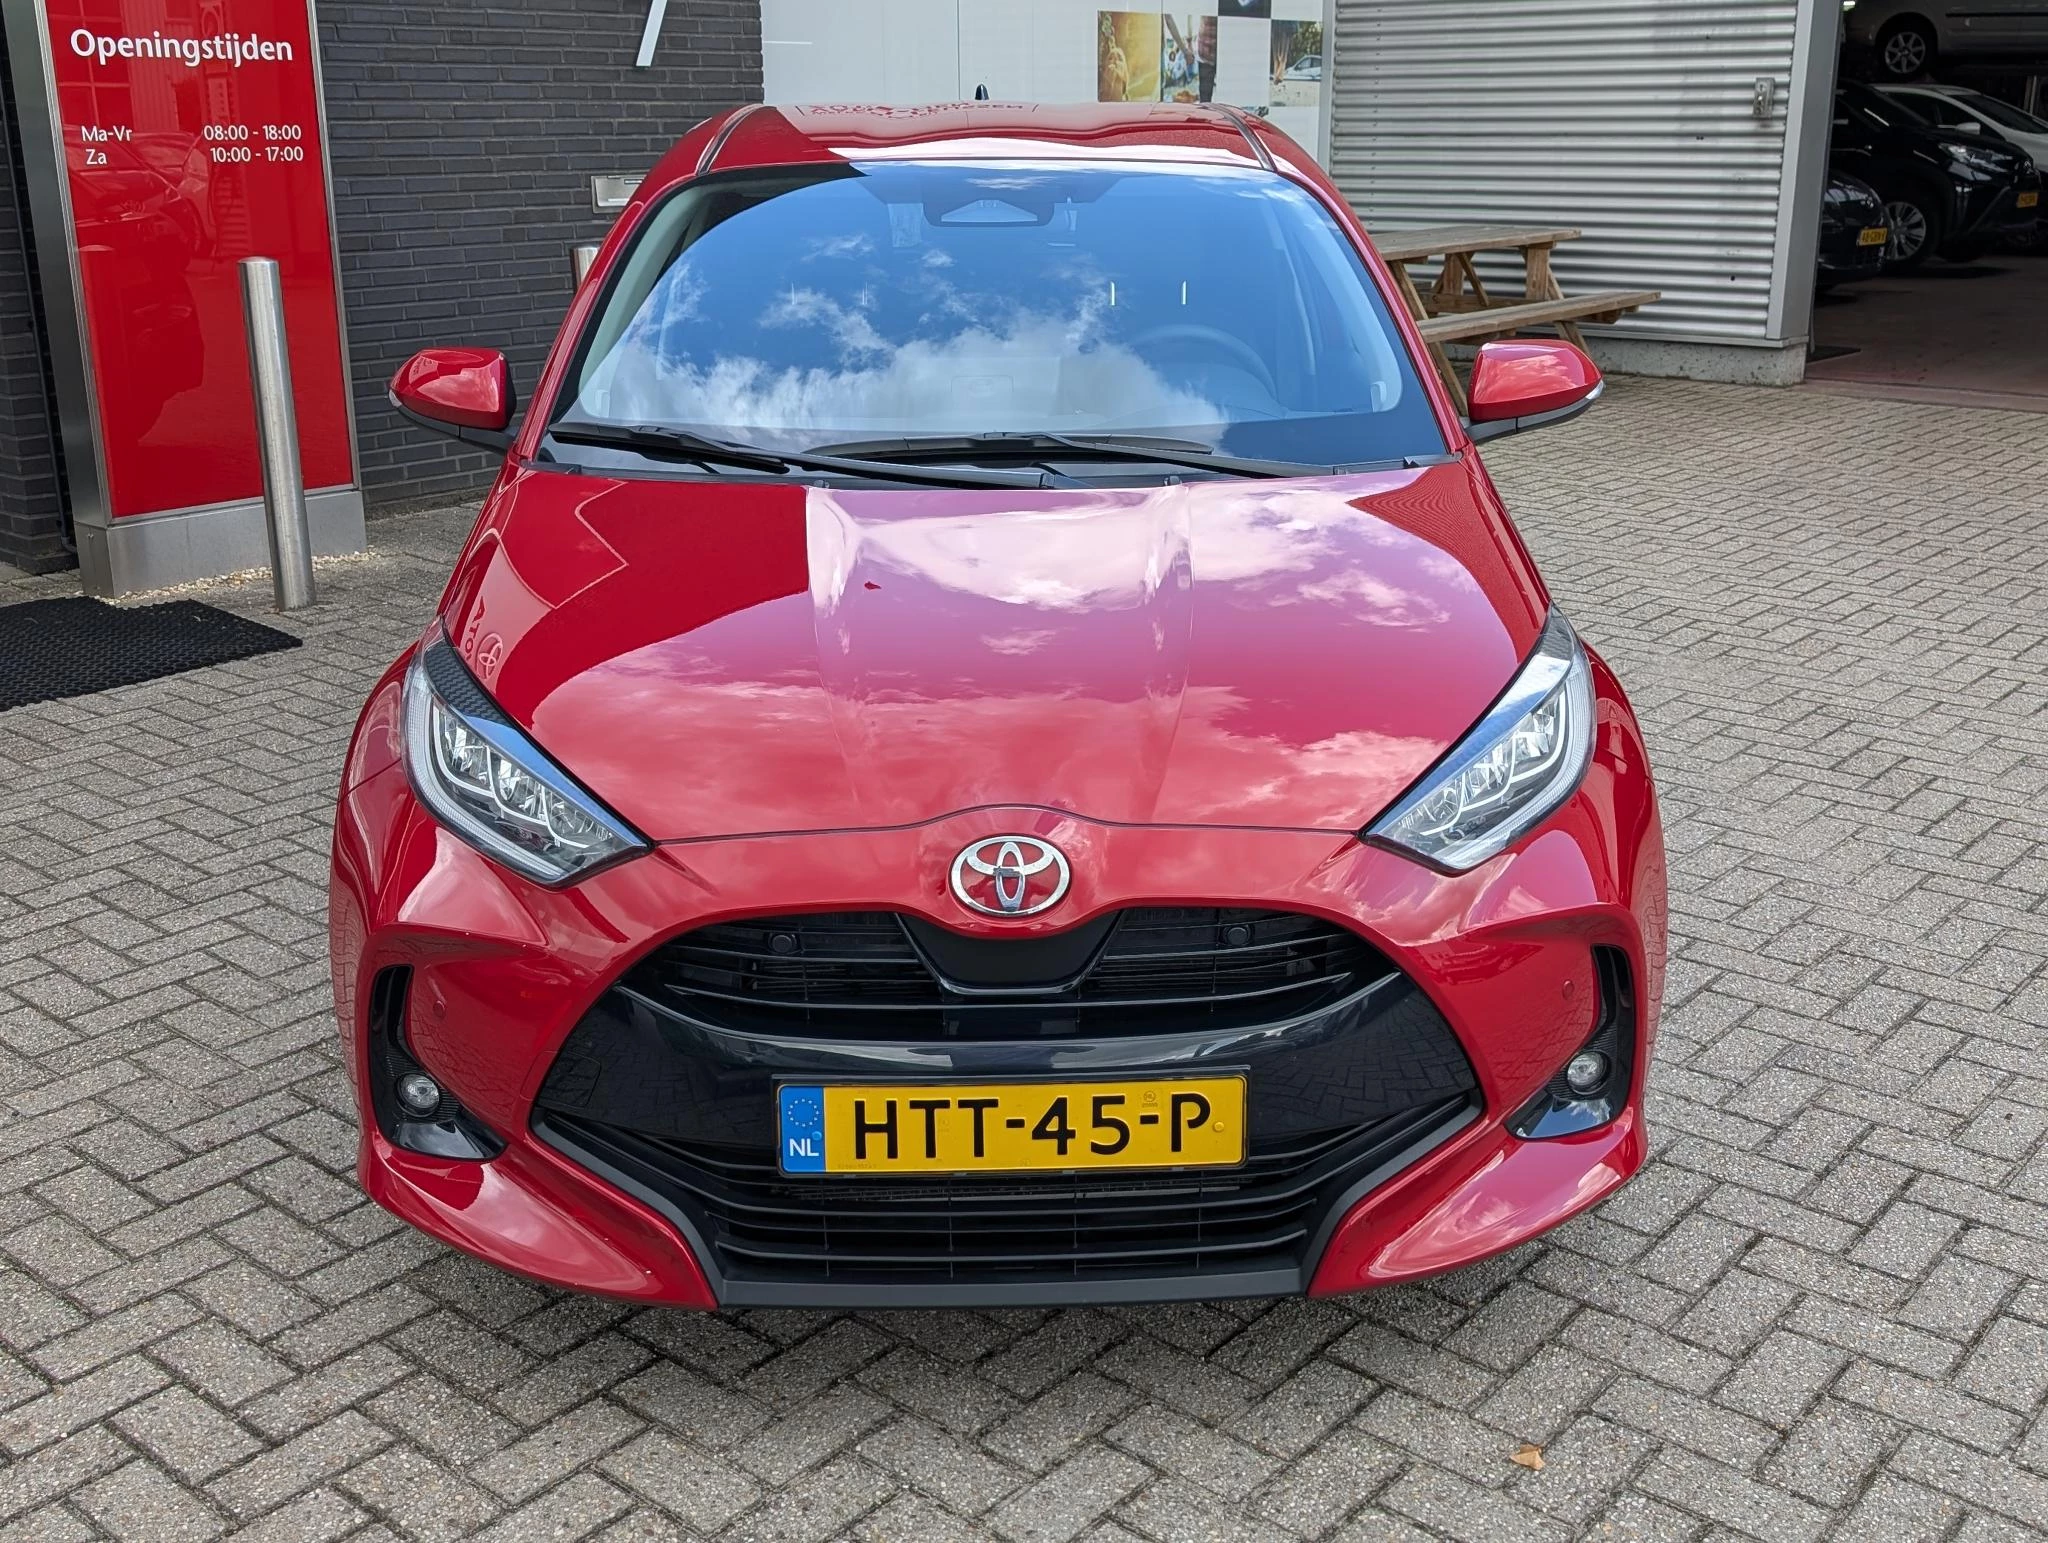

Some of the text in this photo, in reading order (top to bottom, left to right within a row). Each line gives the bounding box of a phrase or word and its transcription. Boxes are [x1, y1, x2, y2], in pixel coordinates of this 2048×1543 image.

[70, 28, 293, 68] Openingstijden
[81, 125, 133, 142] Ma-Vr
[203, 124, 249, 141] 08:00
[262, 124, 302, 140] 18:00
[85, 148, 107, 165] Za
[210, 147, 251, 163] 10:00
[264, 146, 304, 162] 17:00
[854, 1092, 1211, 1160] HTT-45-P
[789, 1137, 820, 1157] NL
